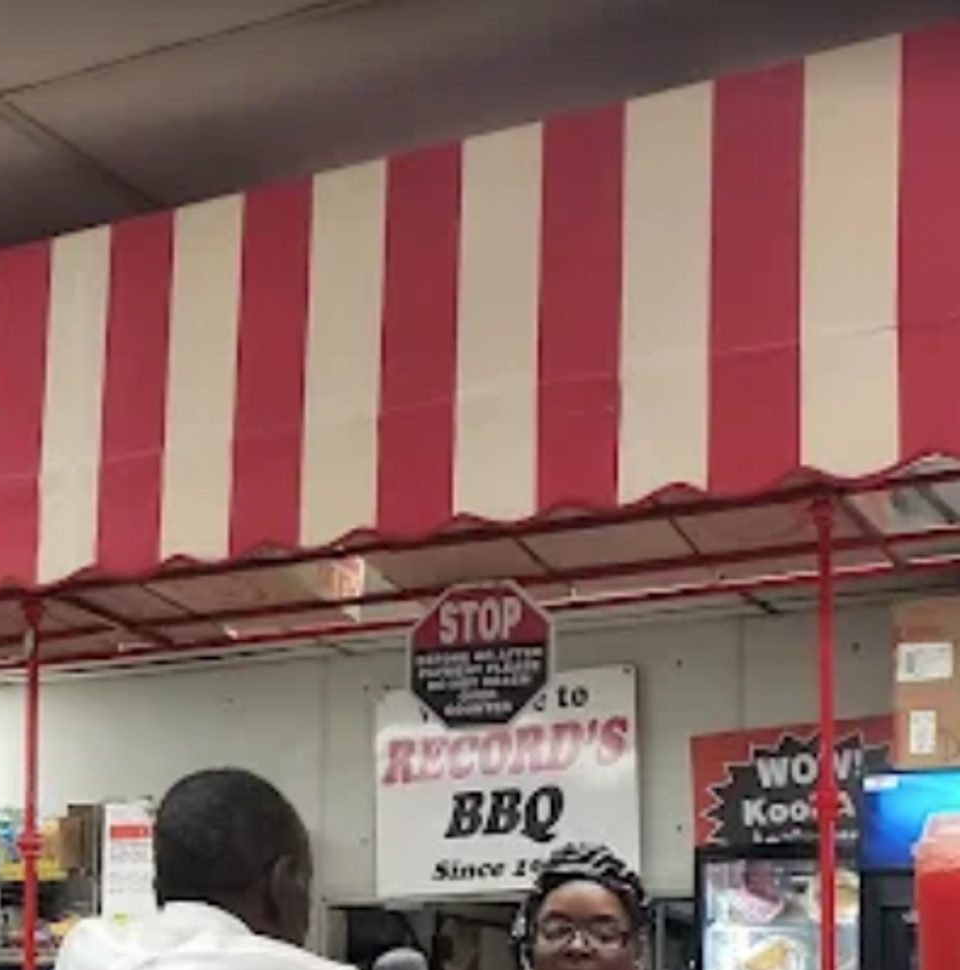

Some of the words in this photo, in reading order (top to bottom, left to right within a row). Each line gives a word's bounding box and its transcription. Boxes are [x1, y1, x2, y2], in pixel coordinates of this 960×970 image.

[439, 597, 523, 643] STOP
[557, 686, 589, 708] to
[382, 715, 629, 785] RECORD'S
[443, 785, 565, 843] BBQ
[431, 859, 505, 882] Since
